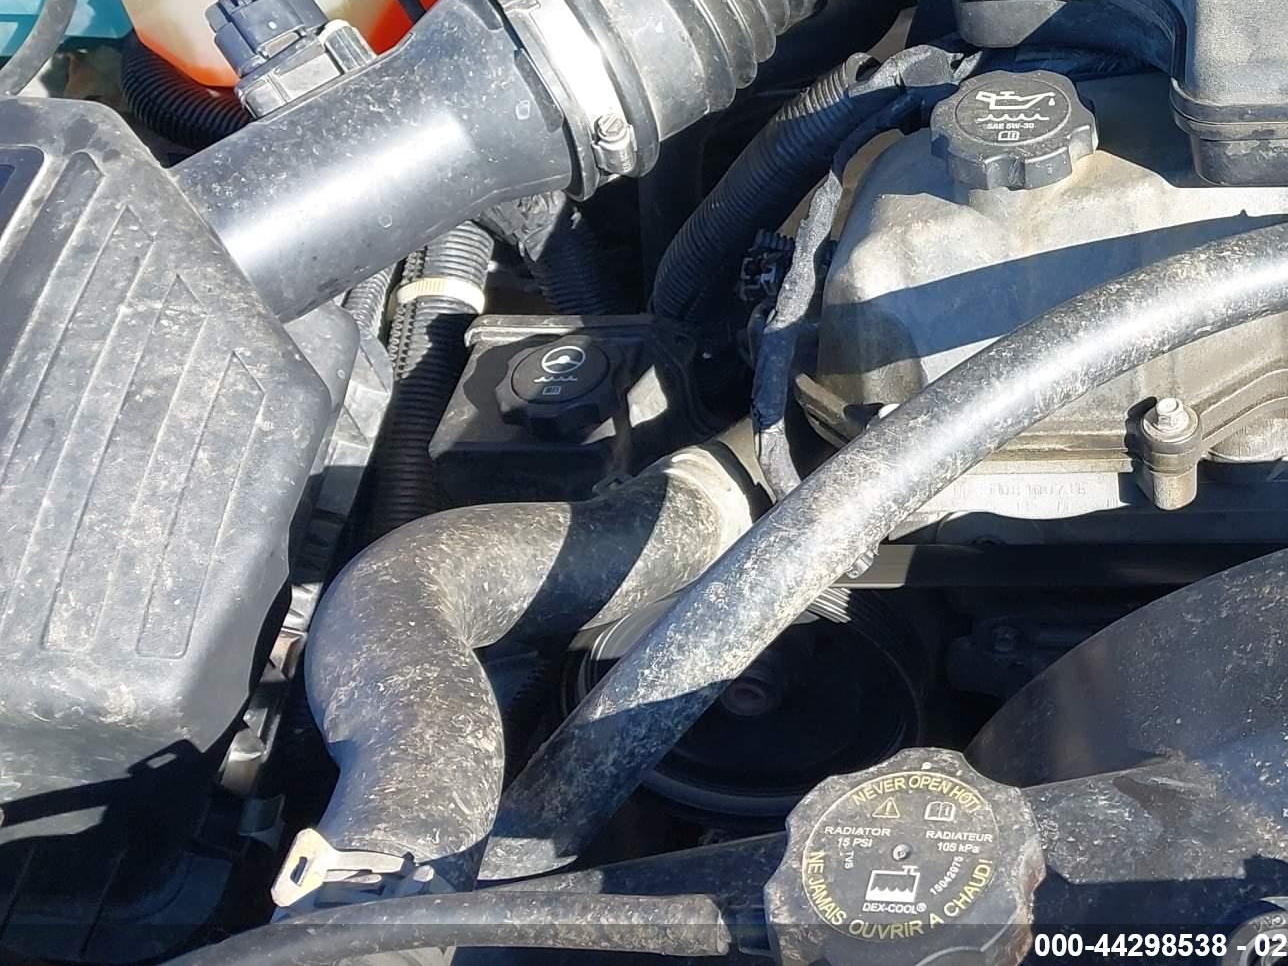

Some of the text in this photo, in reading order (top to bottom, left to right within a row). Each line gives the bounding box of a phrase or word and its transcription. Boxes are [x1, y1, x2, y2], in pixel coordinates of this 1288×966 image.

[986, 122, 1035, 130] SAE 5W-30
[852, 777, 906, 806] NEVER
[908, 775, 952, 794] OPEN
[824, 826, 891, 837] RADIATOR
[925, 830, 993, 843] RADIATEUR
[852, 837, 873, 848] PSI
[936, 841, 980, 854] 105 kPa
[807, 849, 825, 874] NE
[808, 877, 847, 925] JAMAIS
[929, 913, 945, 930] A
[848, 919, 924, 940] OUVRIR
